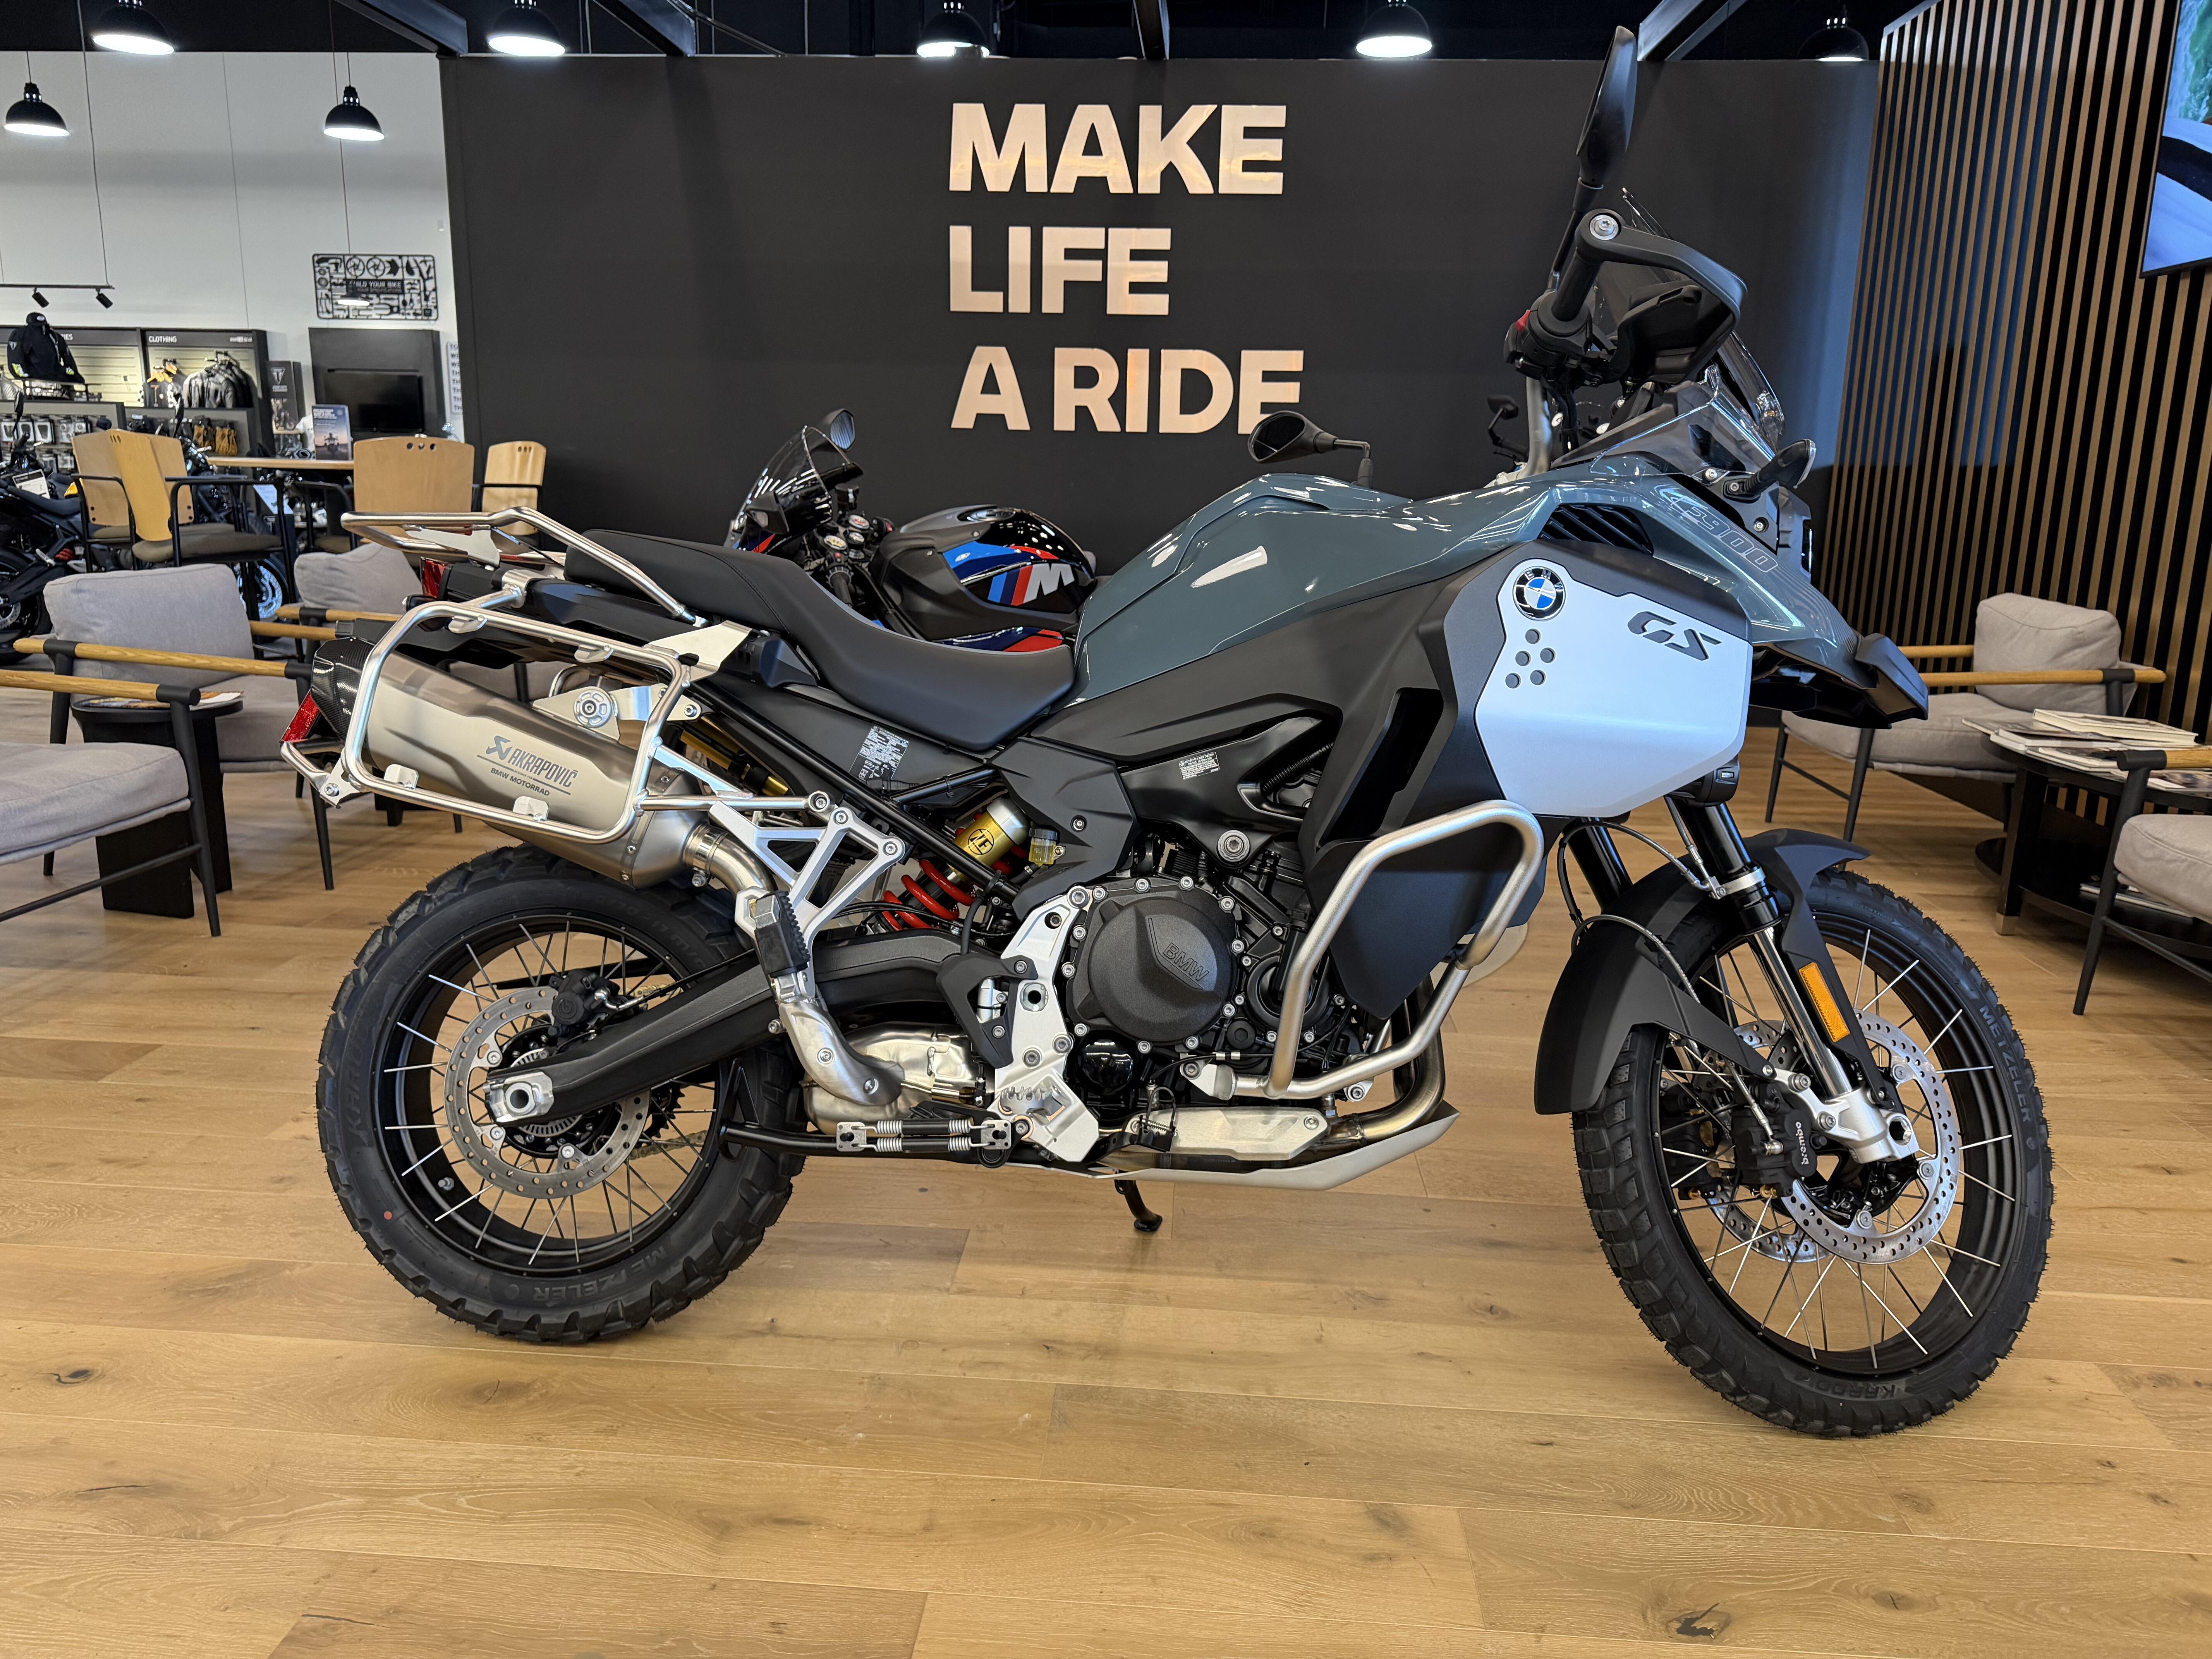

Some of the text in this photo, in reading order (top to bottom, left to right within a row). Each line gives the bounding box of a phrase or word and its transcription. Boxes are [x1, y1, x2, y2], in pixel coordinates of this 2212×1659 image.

[949, 103, 1286, 194] MAKE
[950, 225, 1171, 315] LIFE
[951, 346, 1304, 434] A RIDE
[1023, 563, 1075, 604] M
[1627, 611, 1723, 661] GS
[491, 768, 509, 779] BMW
[510, 776, 550, 796] MOTORRAD
[1163, 942, 1209, 981] BMW
[1979, 1005, 2032, 1122] METZELER
[1796, 1121, 1809, 1165] brembo
[533, 1245, 667, 1301] METZELER
